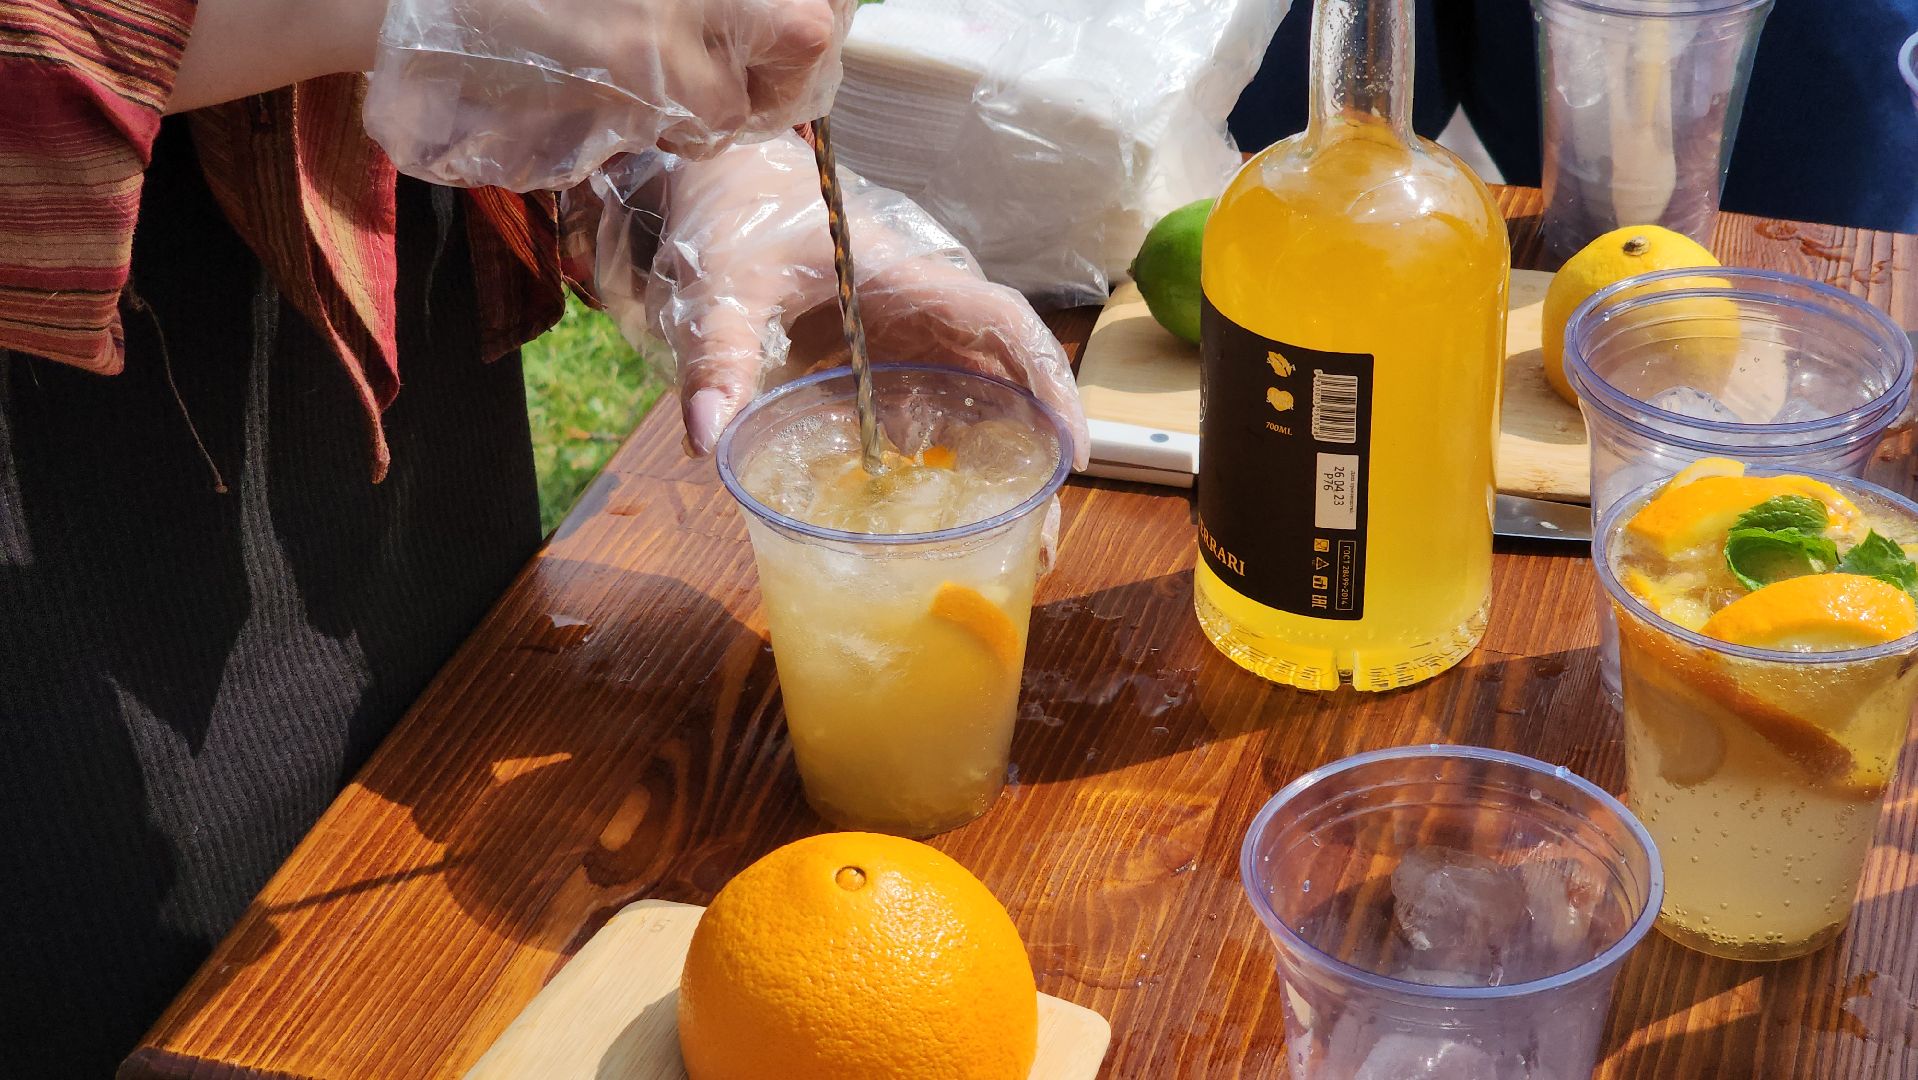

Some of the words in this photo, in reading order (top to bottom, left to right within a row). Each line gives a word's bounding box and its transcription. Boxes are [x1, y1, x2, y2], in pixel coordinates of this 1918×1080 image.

[1265, 421, 1293, 436] 700ML
[1334, 466, 1345, 478] 26
[1333, 480, 1345, 492] 04
[1333, 494, 1345, 506] 23
[1200, 516, 1245, 577] ERRARI
